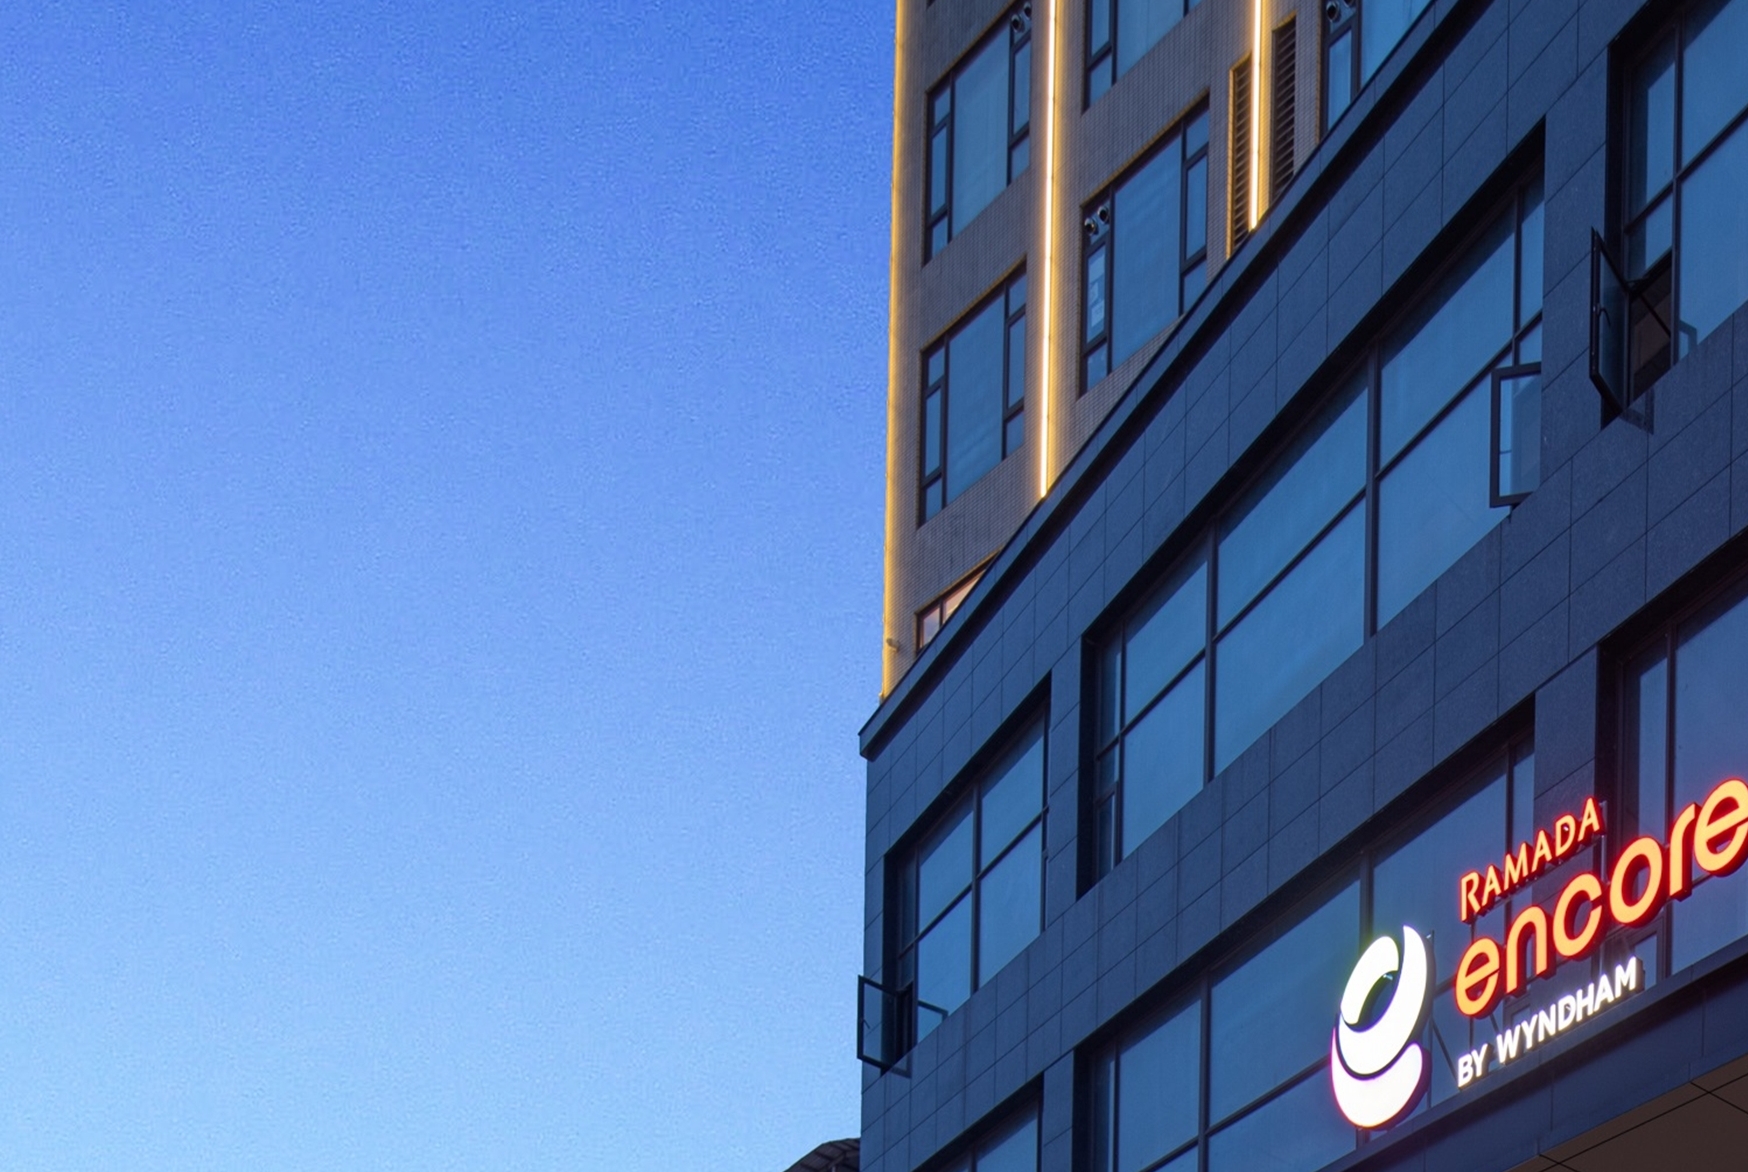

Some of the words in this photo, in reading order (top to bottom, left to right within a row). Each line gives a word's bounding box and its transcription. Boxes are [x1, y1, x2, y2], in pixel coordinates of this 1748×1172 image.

[1459, 797, 1603, 923] RAMADA
[1457, 1043, 1490, 1090] BY
[1496, 956, 1644, 1063] WYNDHAM
